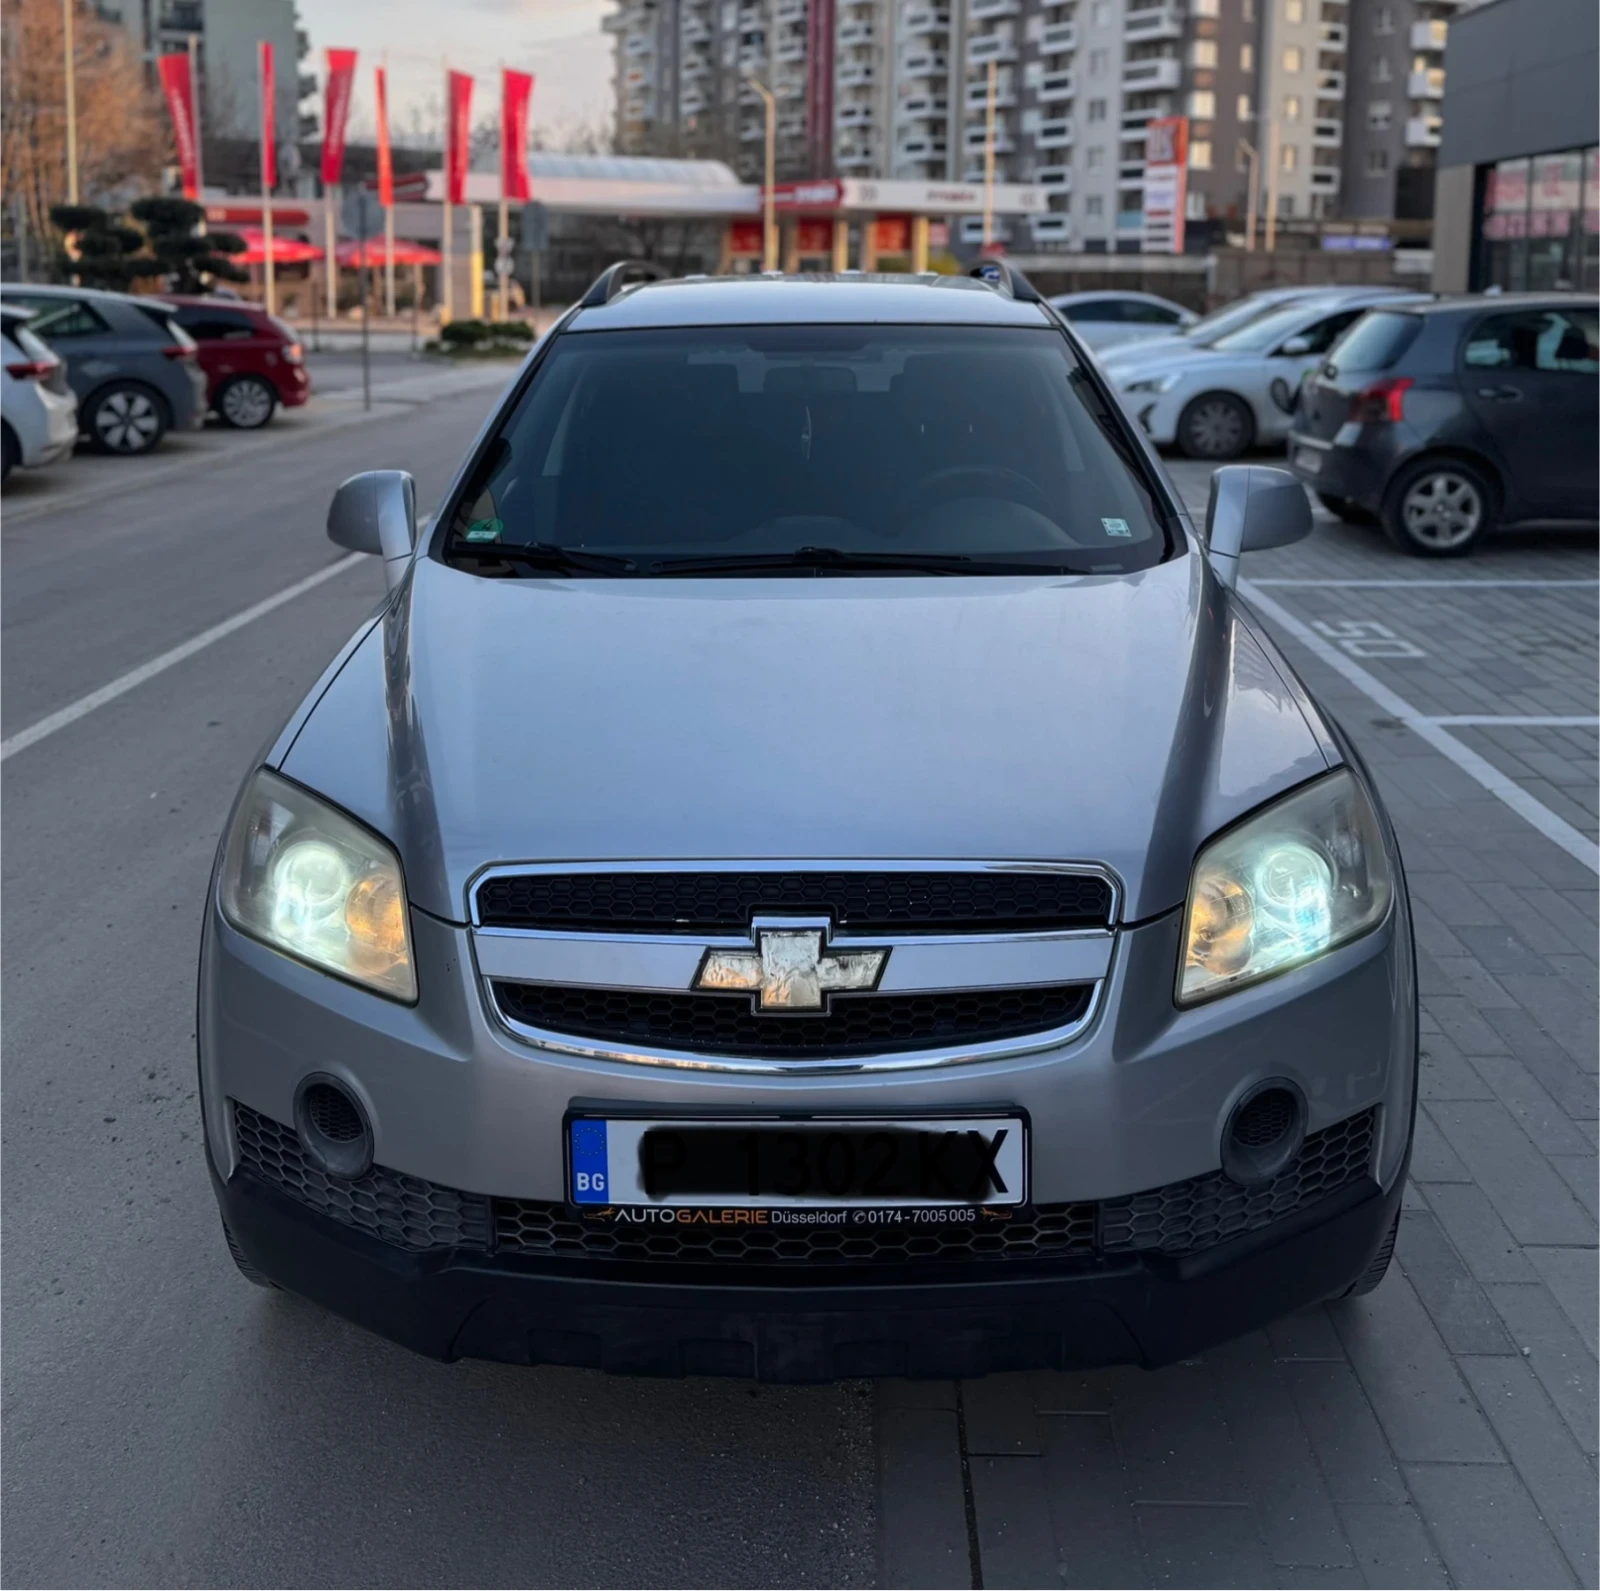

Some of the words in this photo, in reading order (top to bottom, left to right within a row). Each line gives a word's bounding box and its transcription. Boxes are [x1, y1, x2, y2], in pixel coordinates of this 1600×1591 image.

[576, 1172, 605, 1192] BG
[614, 1208, 768, 1224] AUTOGALERIE
[771, 1209, 848, 1224] Düsseldorf
